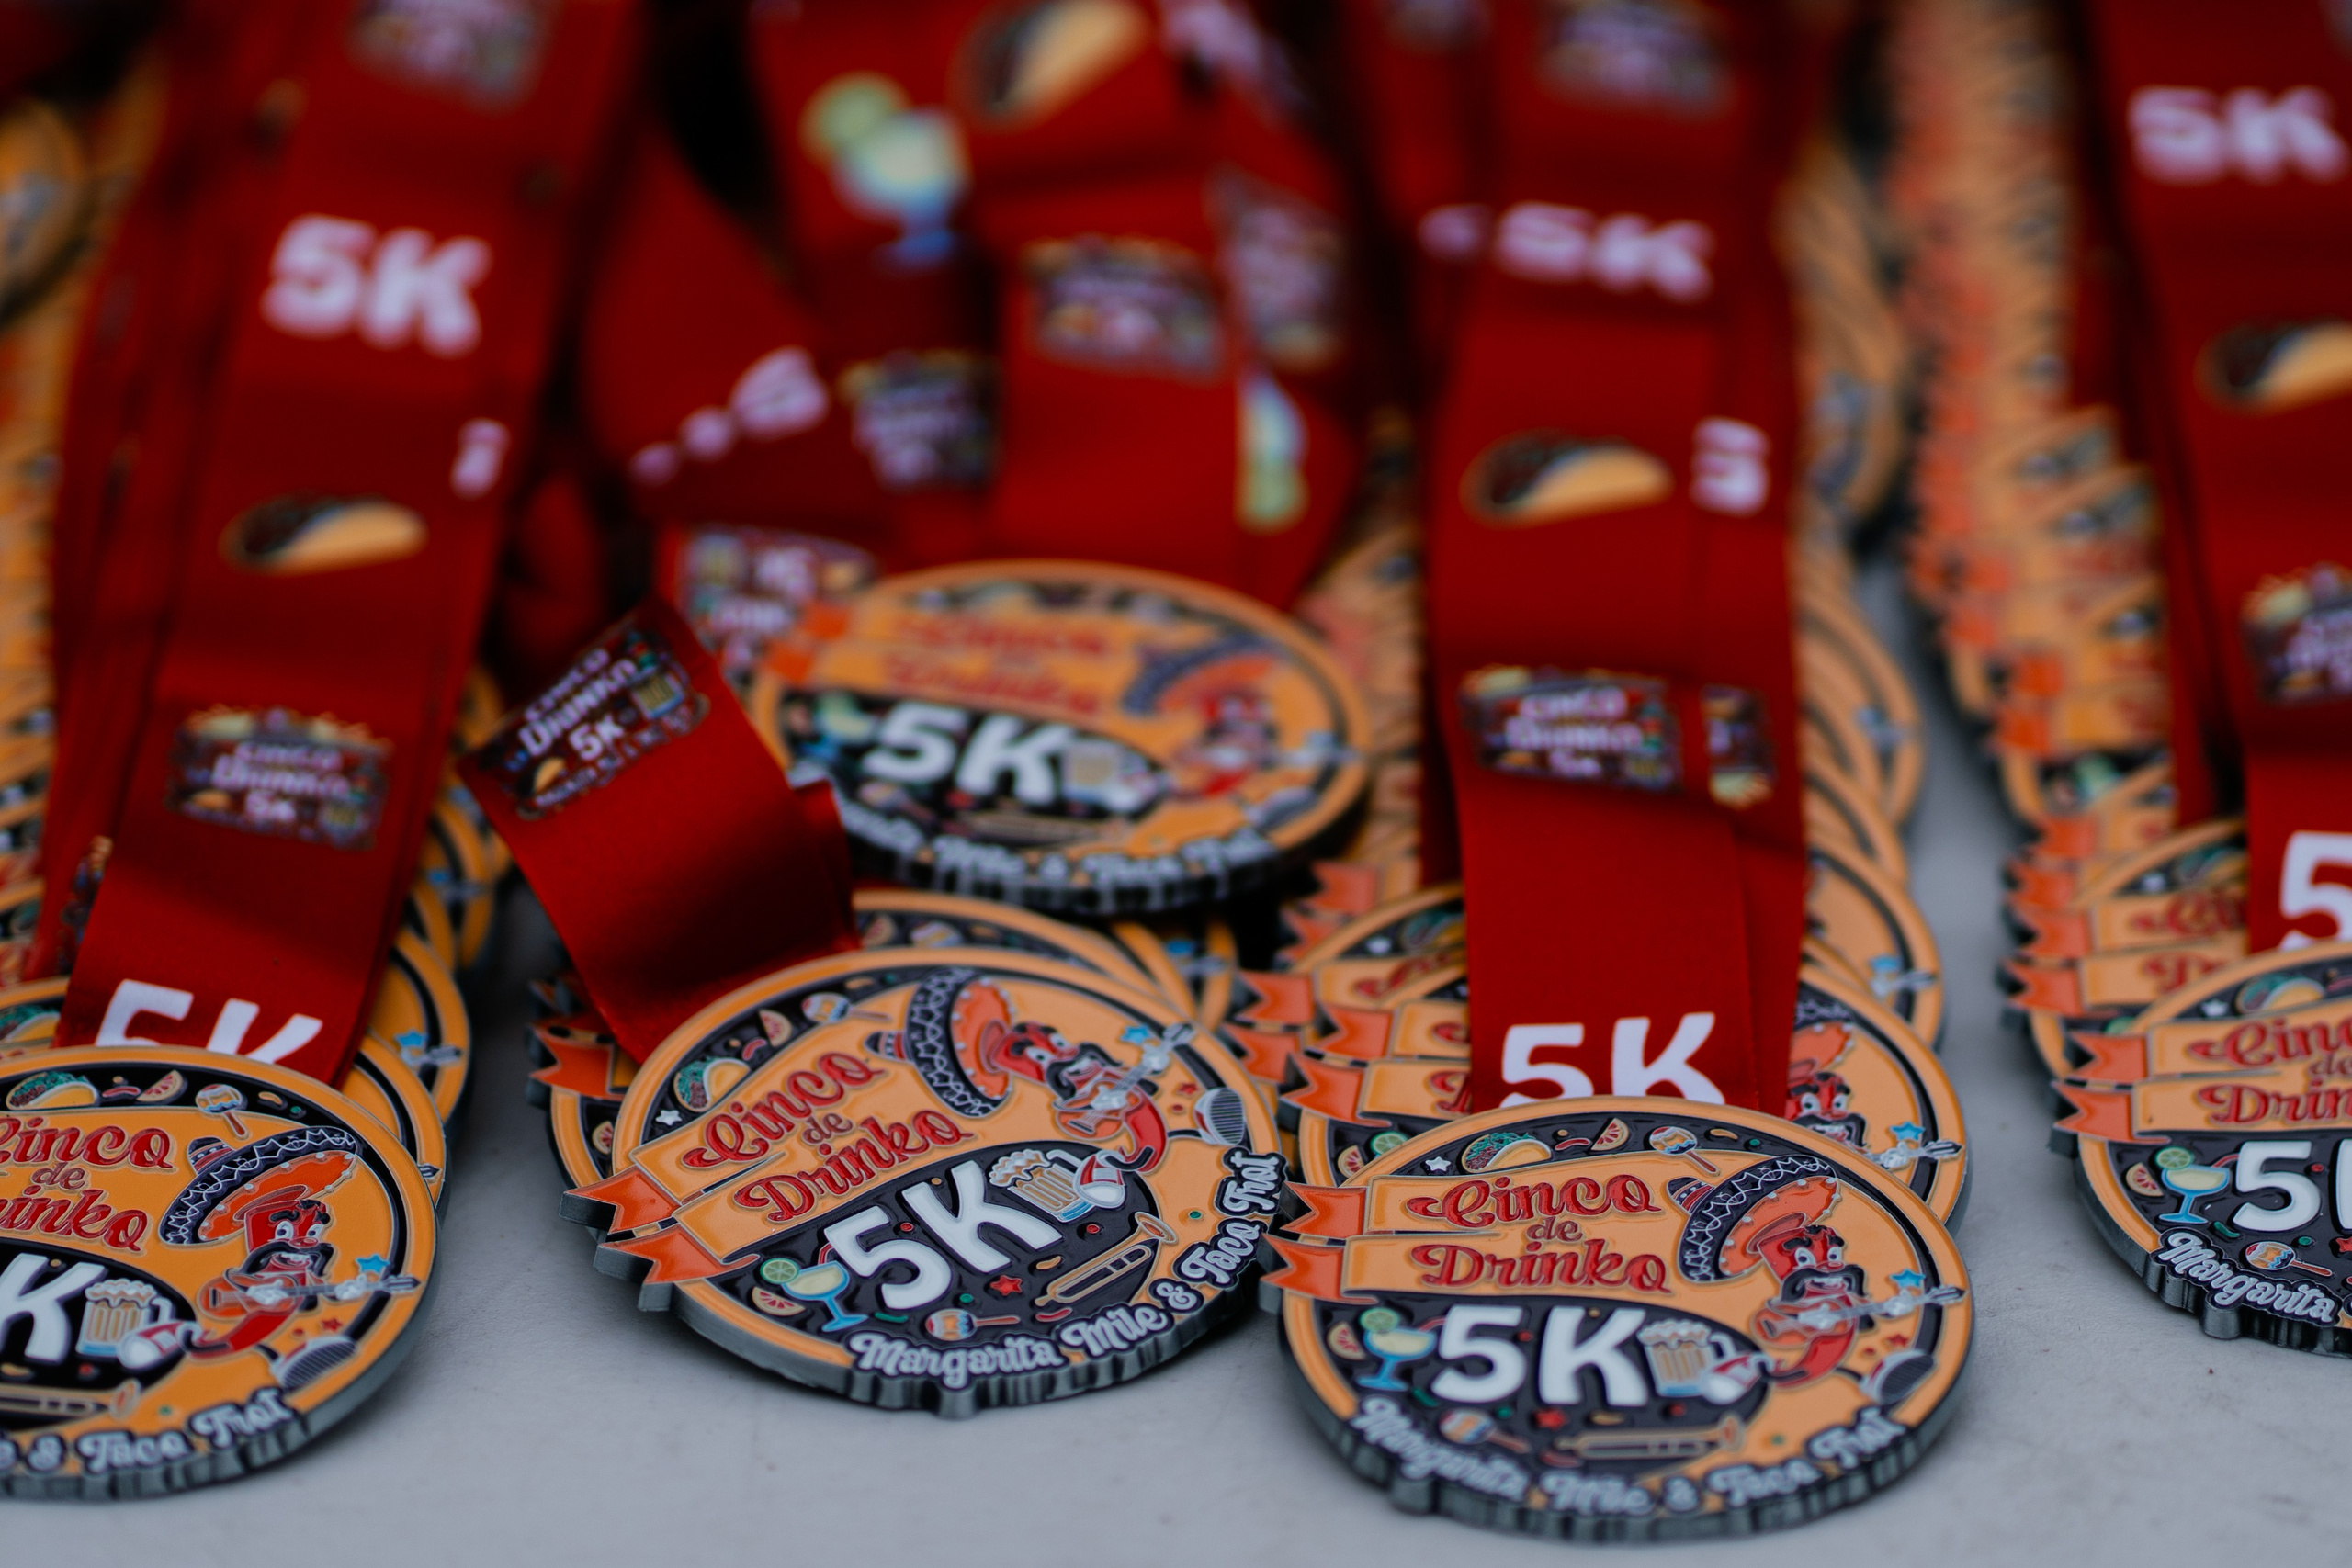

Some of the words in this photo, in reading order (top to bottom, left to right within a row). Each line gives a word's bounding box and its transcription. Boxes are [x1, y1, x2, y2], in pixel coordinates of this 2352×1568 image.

[2127, 85, 2348, 186] 5K
[263, 215, 491, 357] 5K
[1494, 200, 1714, 303] 5K
[864, 702, 1075, 805] 5K
[2279, 831, 2352, 953] 5
[1499, 1012, 1725, 1108] 5K
[2188, 1017, 2352, 1066] Cin
[682, 1052, 888, 1168] Cinco
[802, 1112, 853, 1145] de
[2197, 1077, 2352, 1123] Drin
[31, 1161, 86, 1190] de
[734, 1110, 974, 1223] Drinko
[1407, 1174, 1662, 1228] Cinco
[2233, 1139, 2352, 1232] 5
[824, 1160, 1064, 1310] 5K
[850, 1333, 1064, 1389] Margarita
[1060, 1305, 1169, 1357] Mile
[1156, 1282, 1198, 1311] &
[1181, 1222, 1261, 1285] Taco
[1222, 1151, 1280, 1212] Trot
[1410, 1239, 1672, 1294] Drinko
[1526, 1216, 1583, 1241] de
[2158, 1232, 2335, 1323] Margarita
[0, 1252, 107, 1361] K
[1431, 1304, 1648, 1407] 5K
[76, 1430, 194, 1473] Taco
